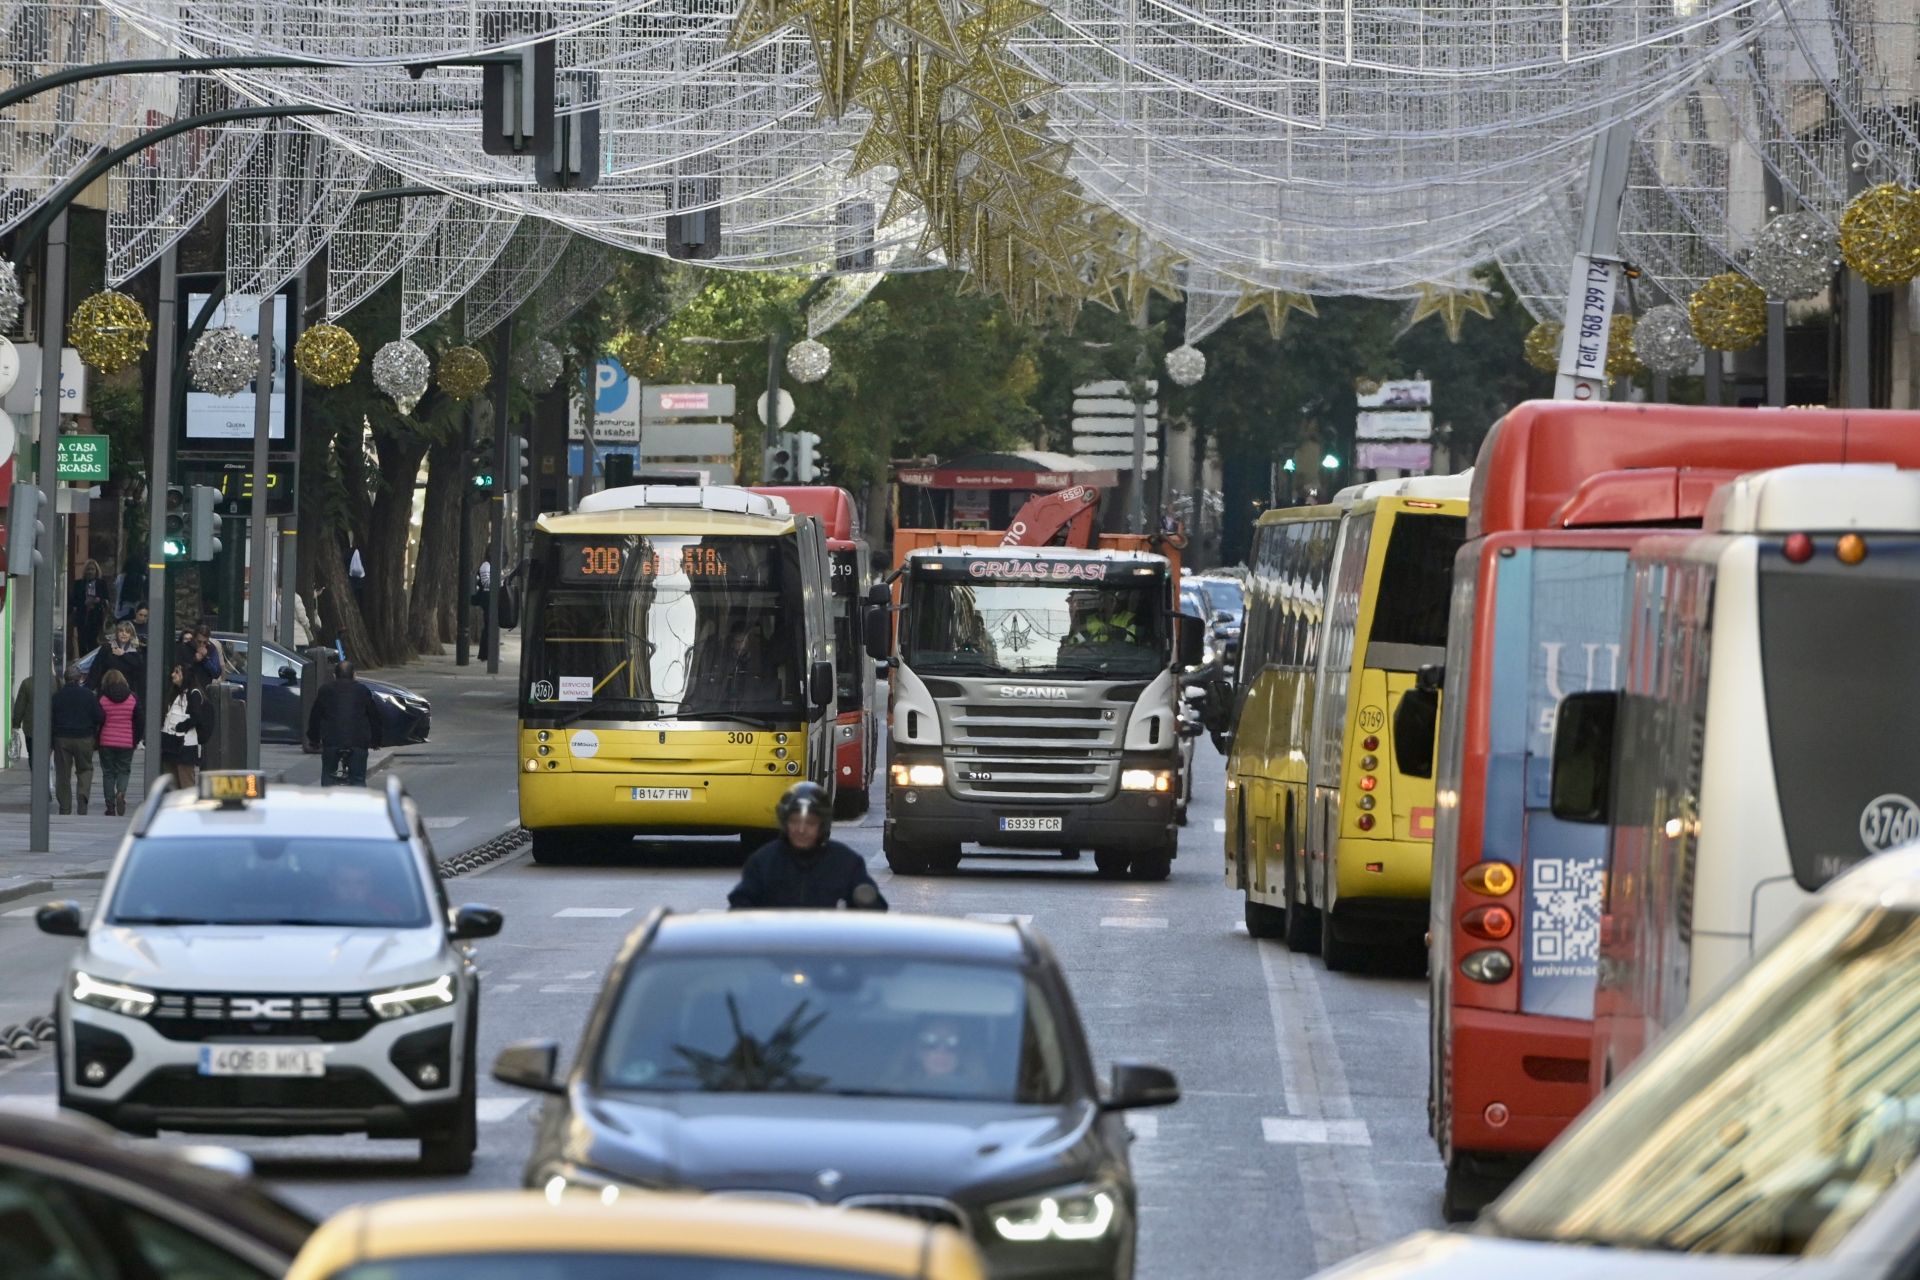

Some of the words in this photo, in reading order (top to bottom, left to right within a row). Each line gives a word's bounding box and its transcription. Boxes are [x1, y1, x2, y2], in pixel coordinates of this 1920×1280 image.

[1587, 260, 1610, 284] 124
[1585, 288, 1607, 312] 299
[1581, 316, 1603, 339] 968
[1576, 343, 1598, 369] Telf.
[68, 443, 97, 452] CASA
[73, 453, 94, 462] LAS
[57, 463, 102, 472] RCASAS
[582, 547, 620, 574] 30B
[1052, 562, 1107, 581] BASI
[1000, 686, 1069, 699] SCANIA
[727, 731, 754, 745] 300
[639, 788, 666, 799] 8147
[668, 789, 689, 799] FHV
[1007, 818, 1036, 830] 6939
[1038, 818, 1060, 830] FCR
[1866, 805, 1918, 845] 3760
